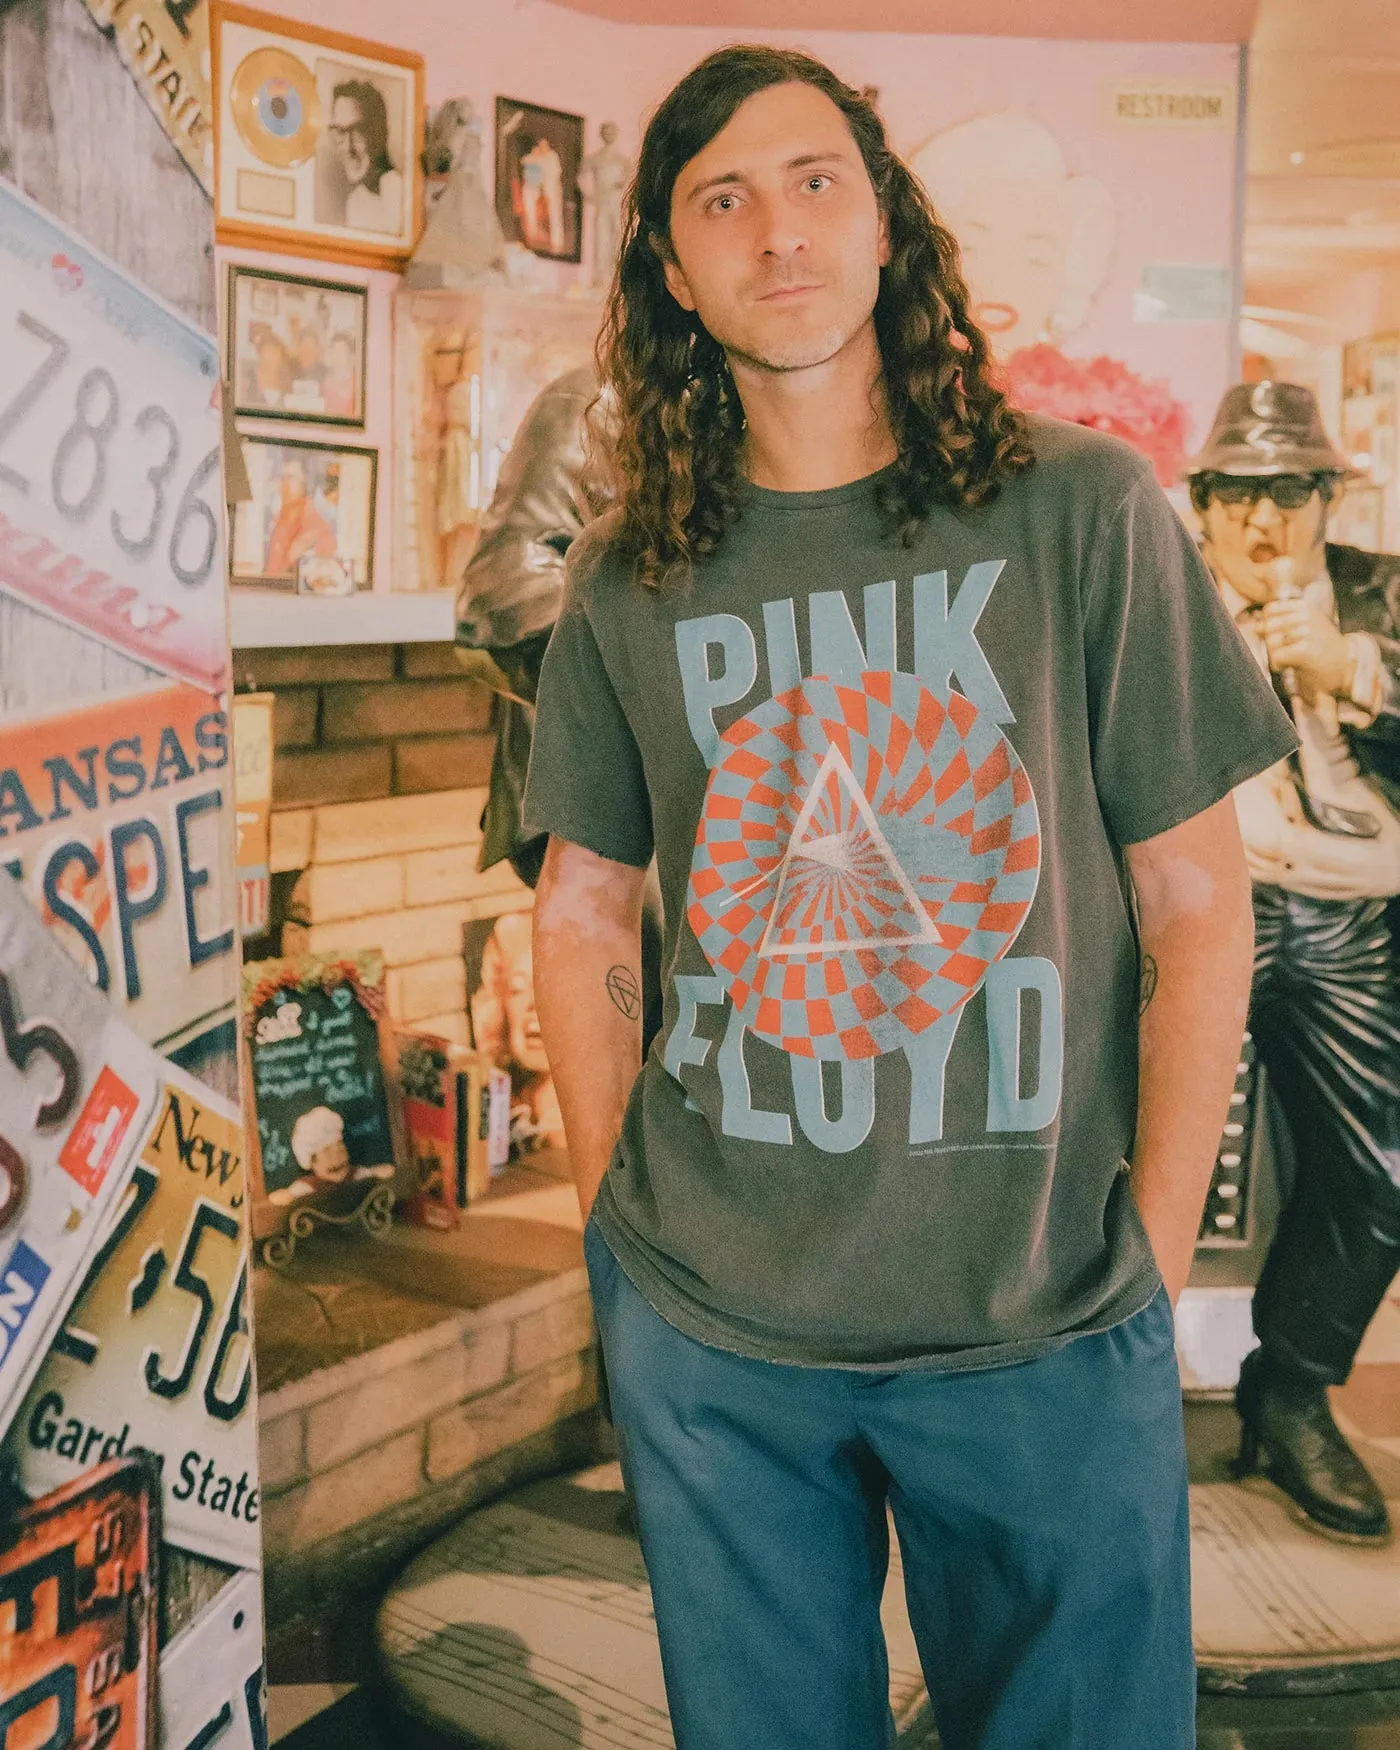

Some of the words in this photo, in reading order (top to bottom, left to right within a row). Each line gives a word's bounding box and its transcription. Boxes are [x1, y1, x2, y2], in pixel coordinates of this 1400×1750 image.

[1115, 93, 1223, 119] RESTROOM
[674, 559, 1018, 770] PINK
[663, 956, 1063, 1155] FLOYD
[151, 1094, 241, 1187] New
[171, 1450, 259, 1524] State
